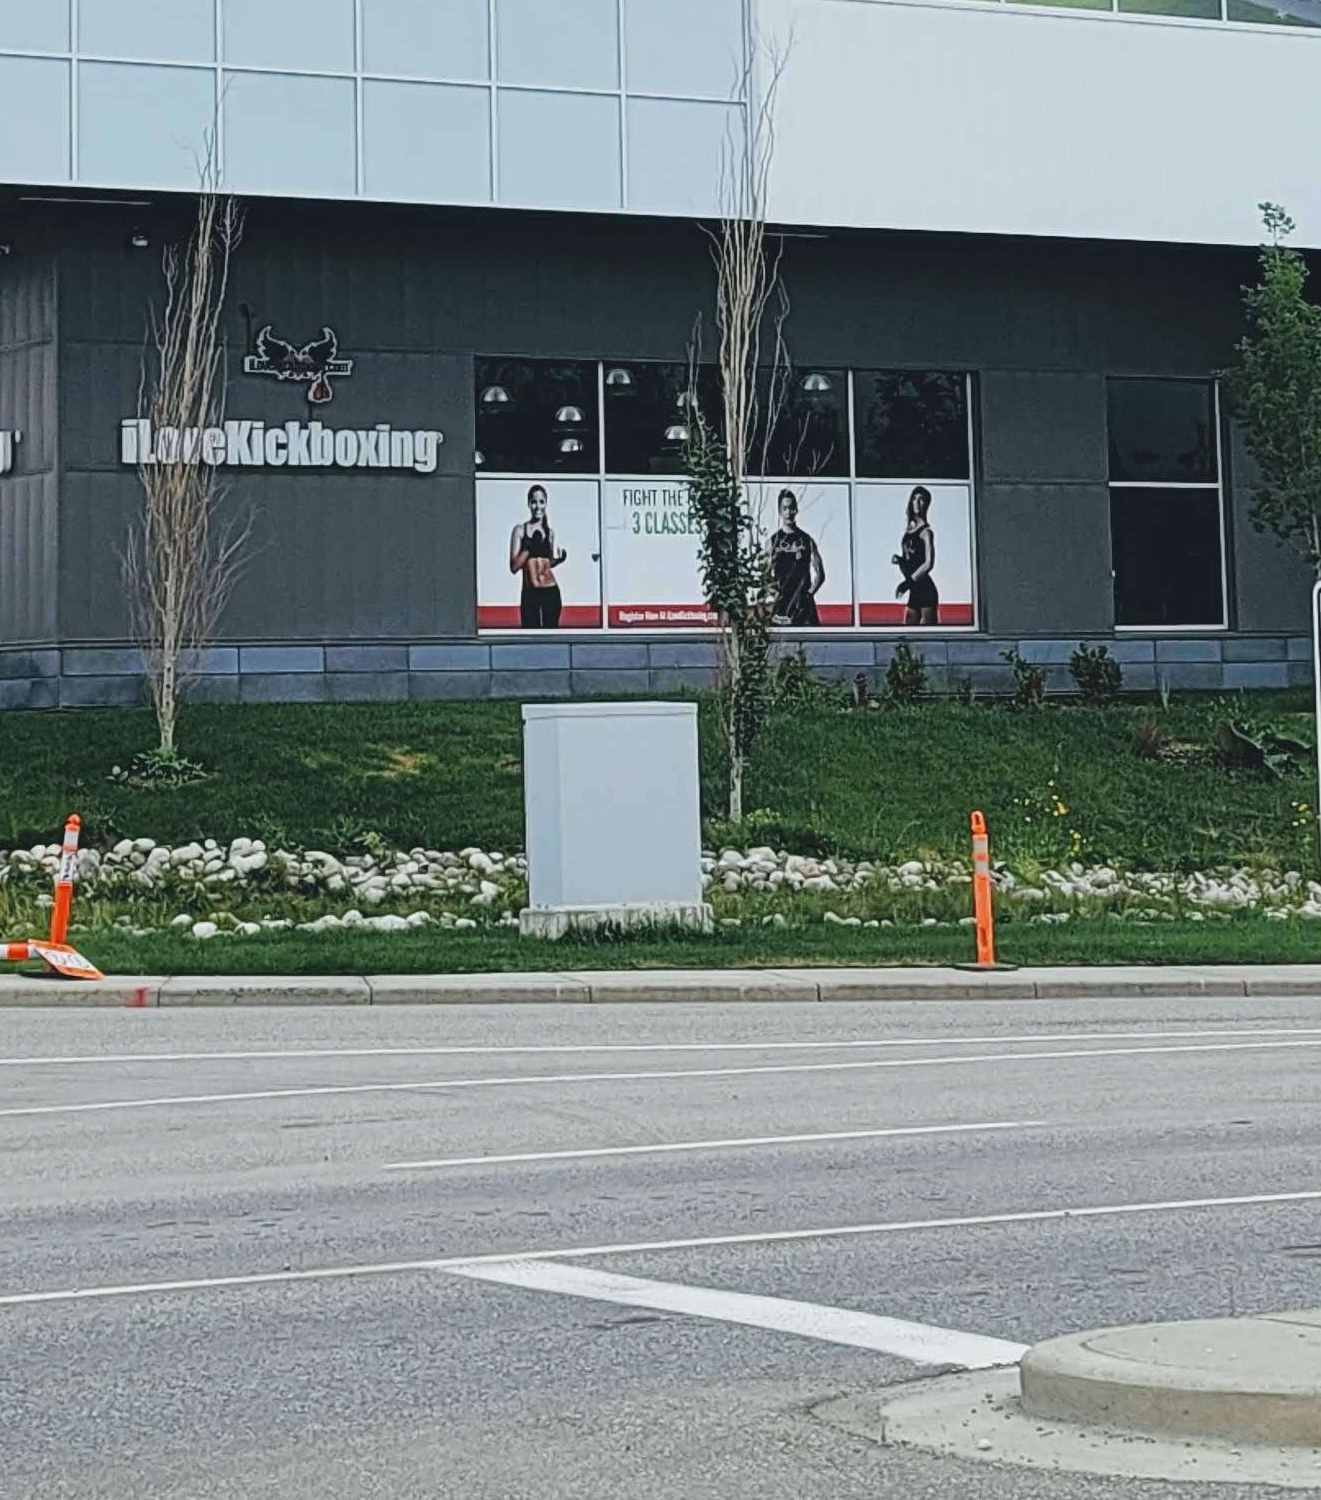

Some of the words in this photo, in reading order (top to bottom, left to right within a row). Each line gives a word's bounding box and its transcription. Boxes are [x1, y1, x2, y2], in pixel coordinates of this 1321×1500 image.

[622, 488, 658, 507] FIGHT
[661, 488, 684, 507] THE
[632, 511, 641, 535] 3
